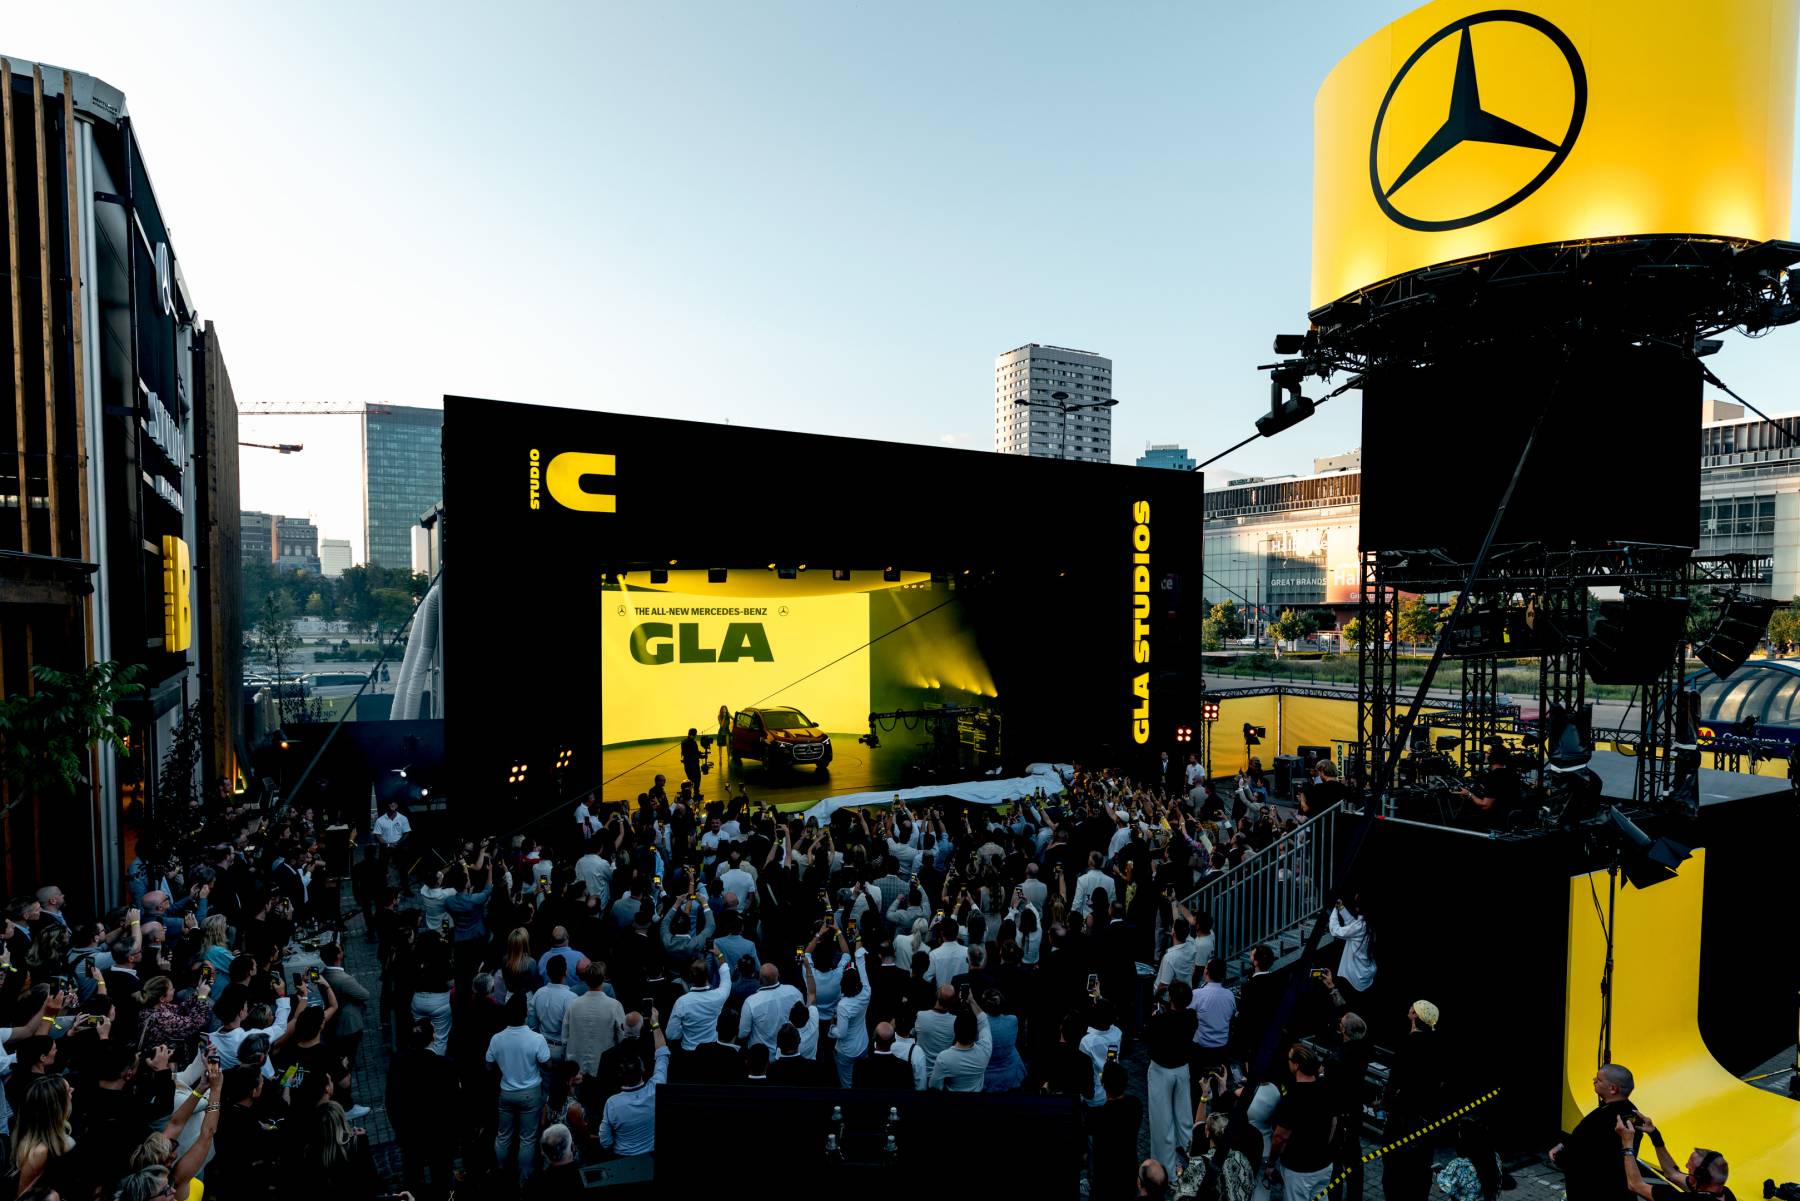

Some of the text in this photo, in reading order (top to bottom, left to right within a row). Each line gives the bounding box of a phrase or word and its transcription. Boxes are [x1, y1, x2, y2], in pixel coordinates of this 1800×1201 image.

[529, 448, 540, 510] STUDIO
[545, 451, 617, 513] C
[162, 535, 192, 653] B
[634, 606, 768, 616] THE ALL-NEW MERCEDES-BENZ
[1270, 577, 1328, 587] GREAT BRANDS
[630, 622, 775, 665] GLA
[1132, 500, 1151, 745] GLA STUDIOS
